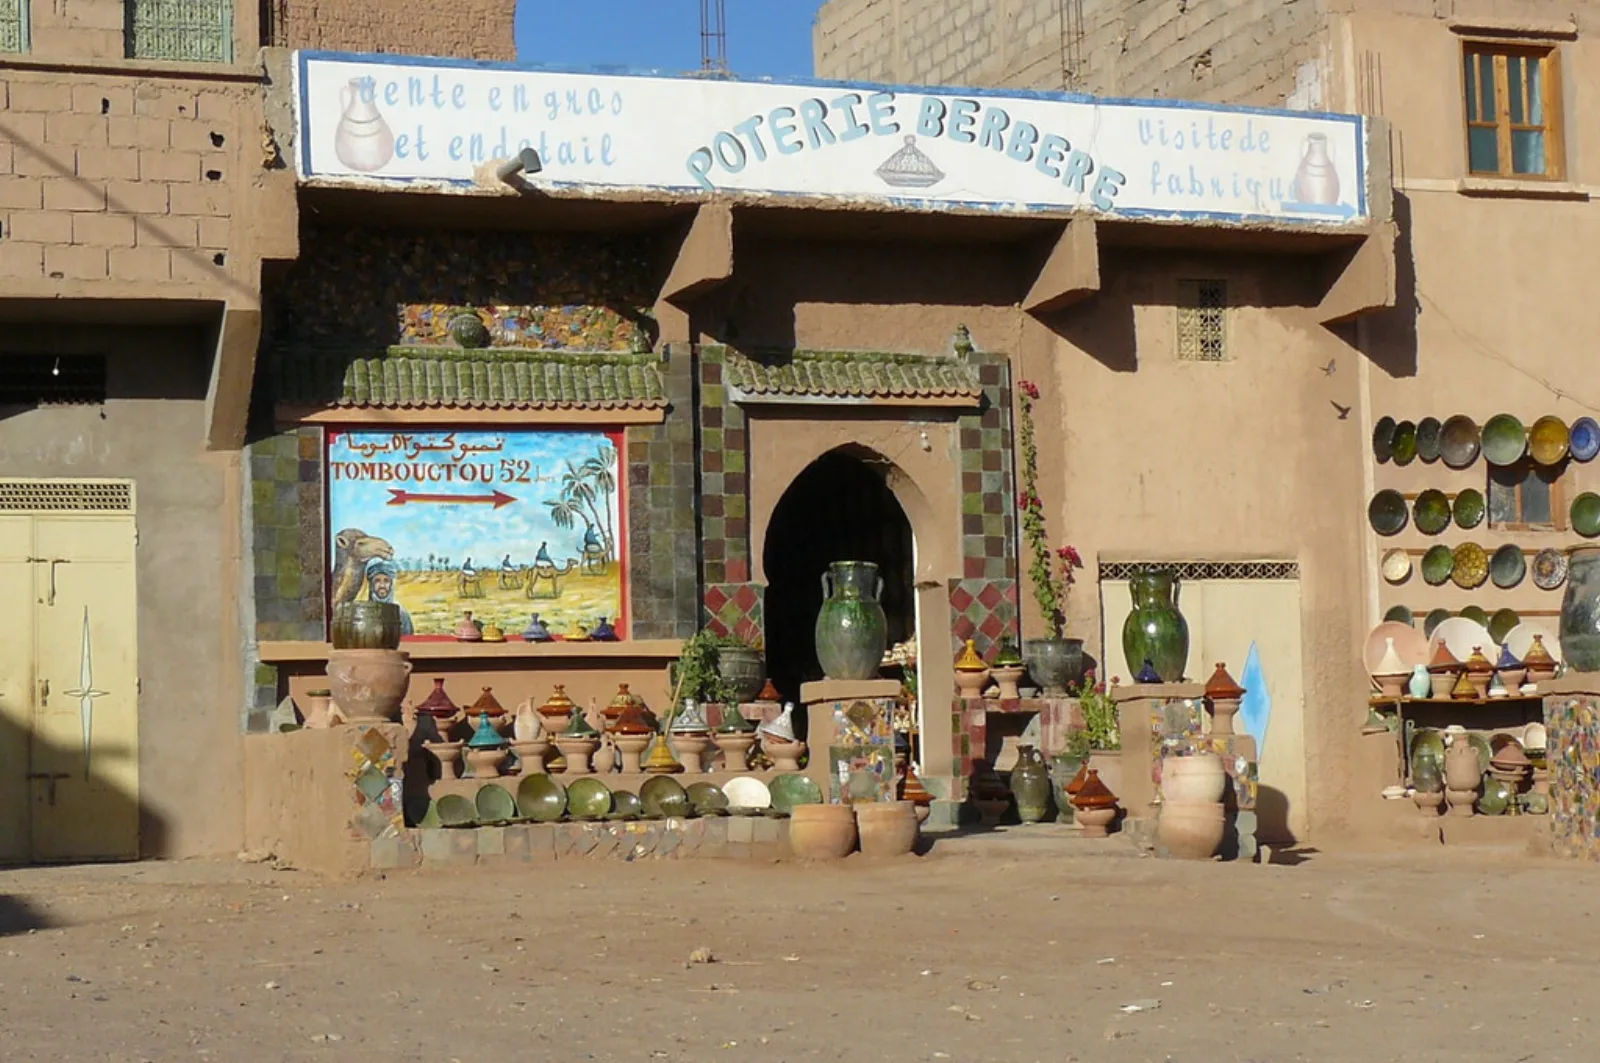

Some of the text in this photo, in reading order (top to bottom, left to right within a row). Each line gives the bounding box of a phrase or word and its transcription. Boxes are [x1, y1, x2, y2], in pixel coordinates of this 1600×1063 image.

[394, 125, 430, 162] et
[684, 91, 1127, 212] POTERIE BERBERE
[330, 461, 494, 483] TOMBOUCTOU
[500, 458, 532, 483] 52
